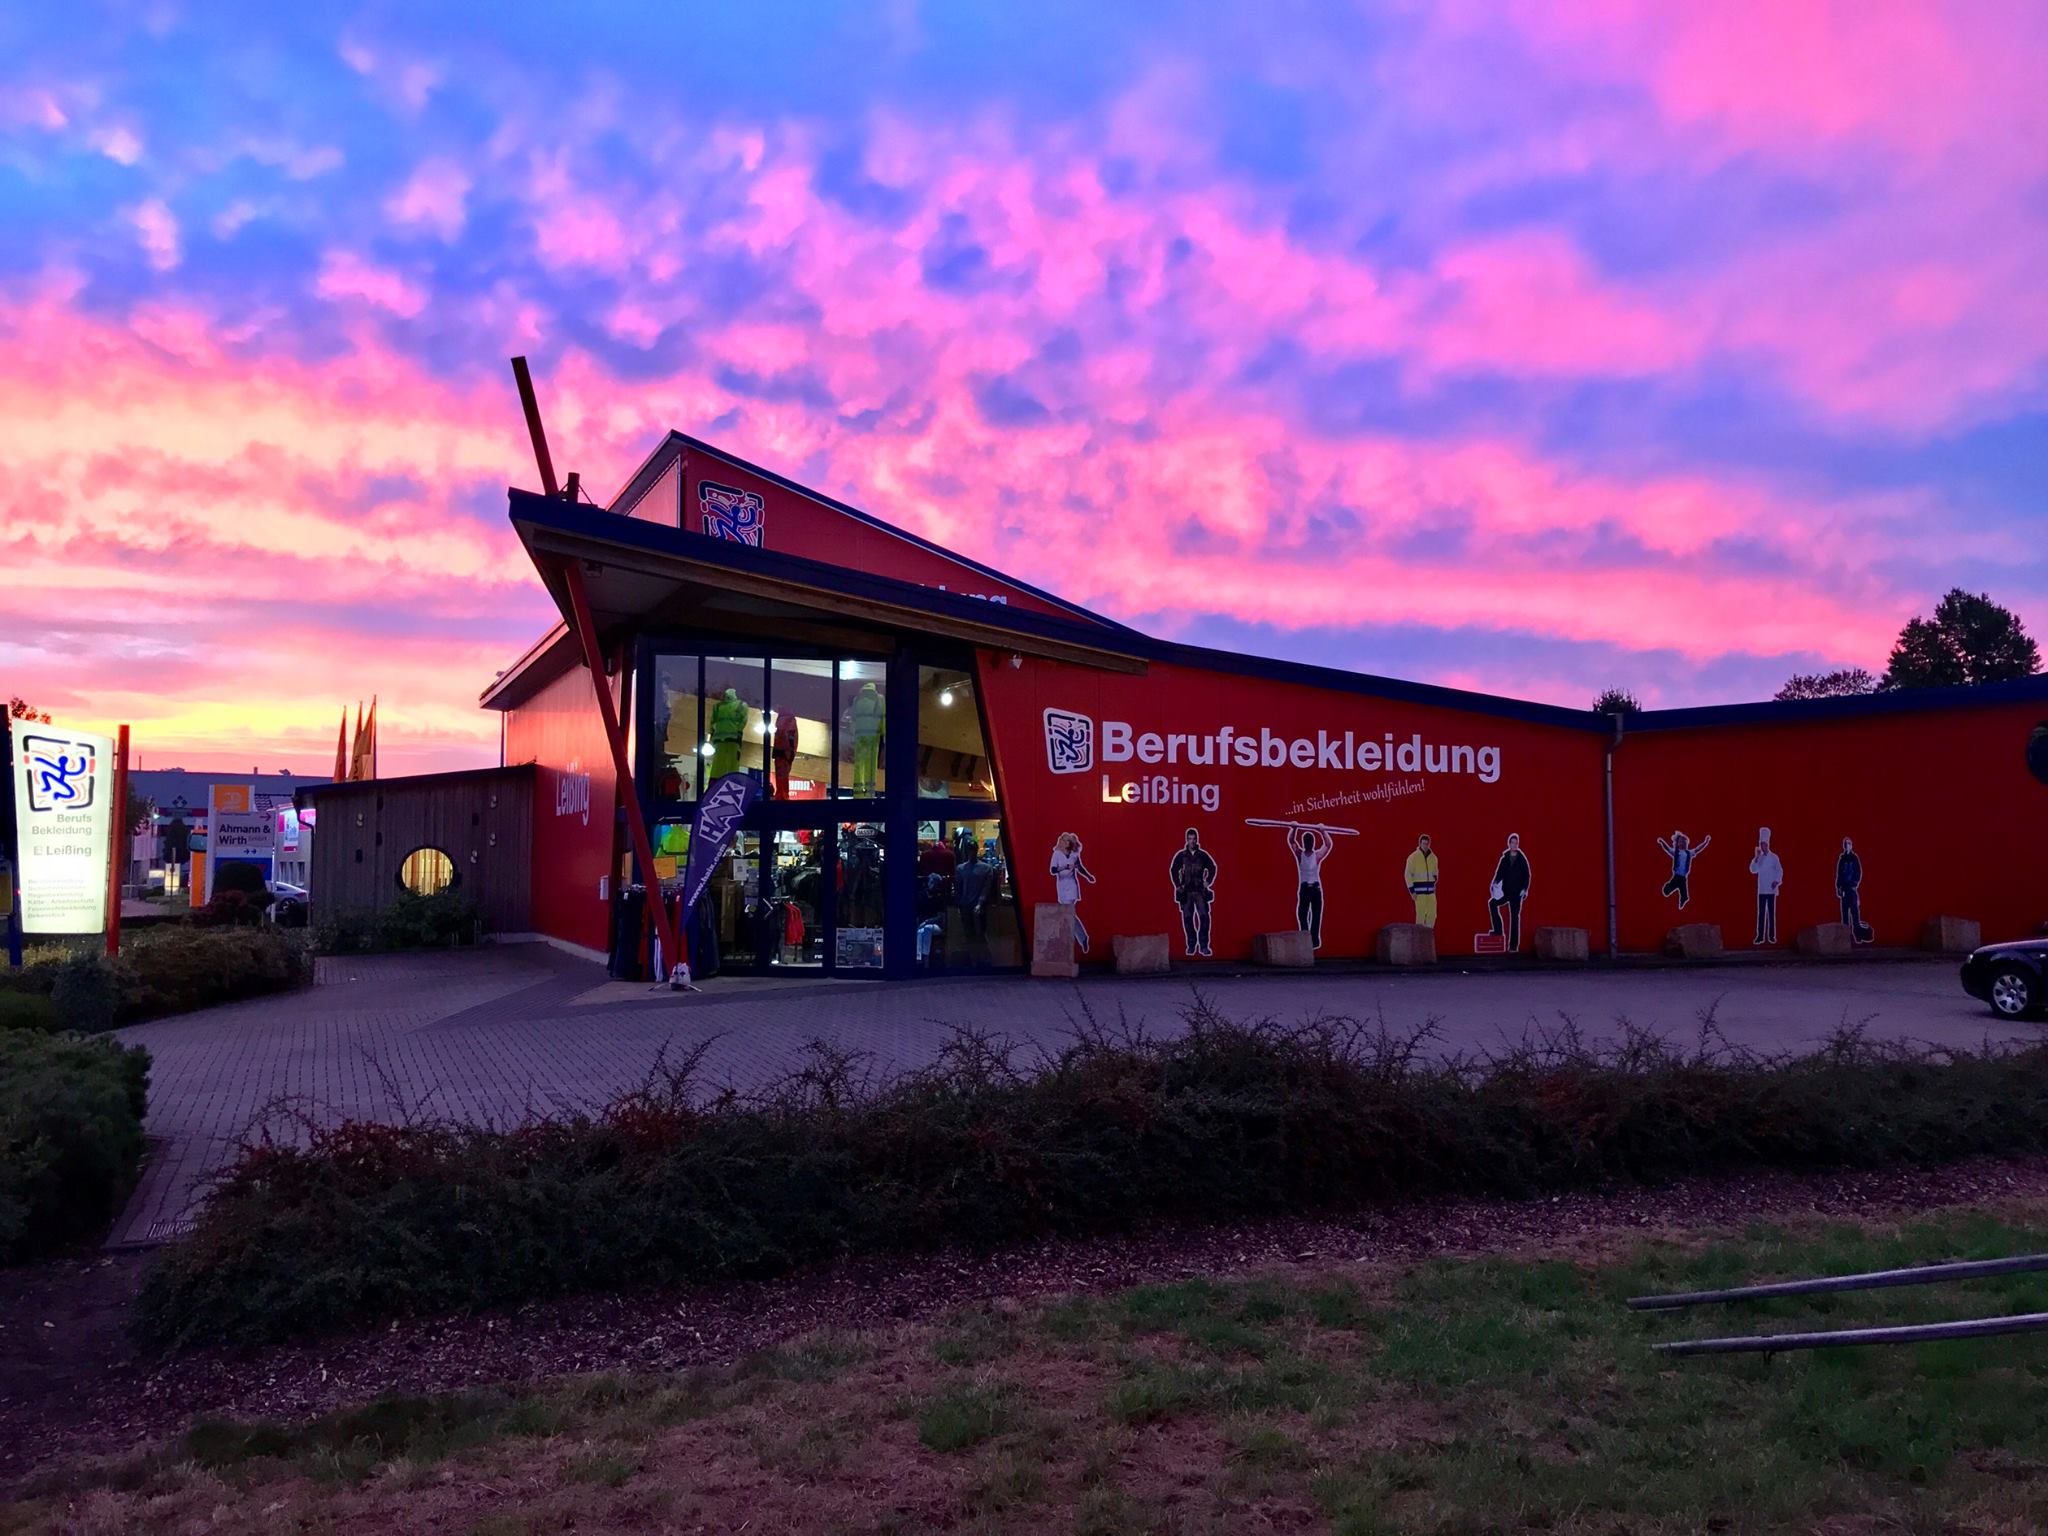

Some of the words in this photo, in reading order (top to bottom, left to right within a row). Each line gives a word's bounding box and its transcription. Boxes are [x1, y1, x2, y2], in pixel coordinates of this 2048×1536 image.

[1101, 720, 1501, 784] Berufsbekleidung
[1101, 774, 1221, 812] Leißing
[1307, 792, 1361, 812] Sicherheit
[1362, 778, 1426, 802] wohlfühlen!
[56, 814, 93, 823] Berufs
[31, 825, 93, 836] Bekleidung
[219, 823, 261, 834] Ahmann
[262, 824, 271, 834] &
[219, 835, 248, 845] Wirth
[46, 845, 93, 857] Leißing
[687, 843, 728, 907] www.haix.com
